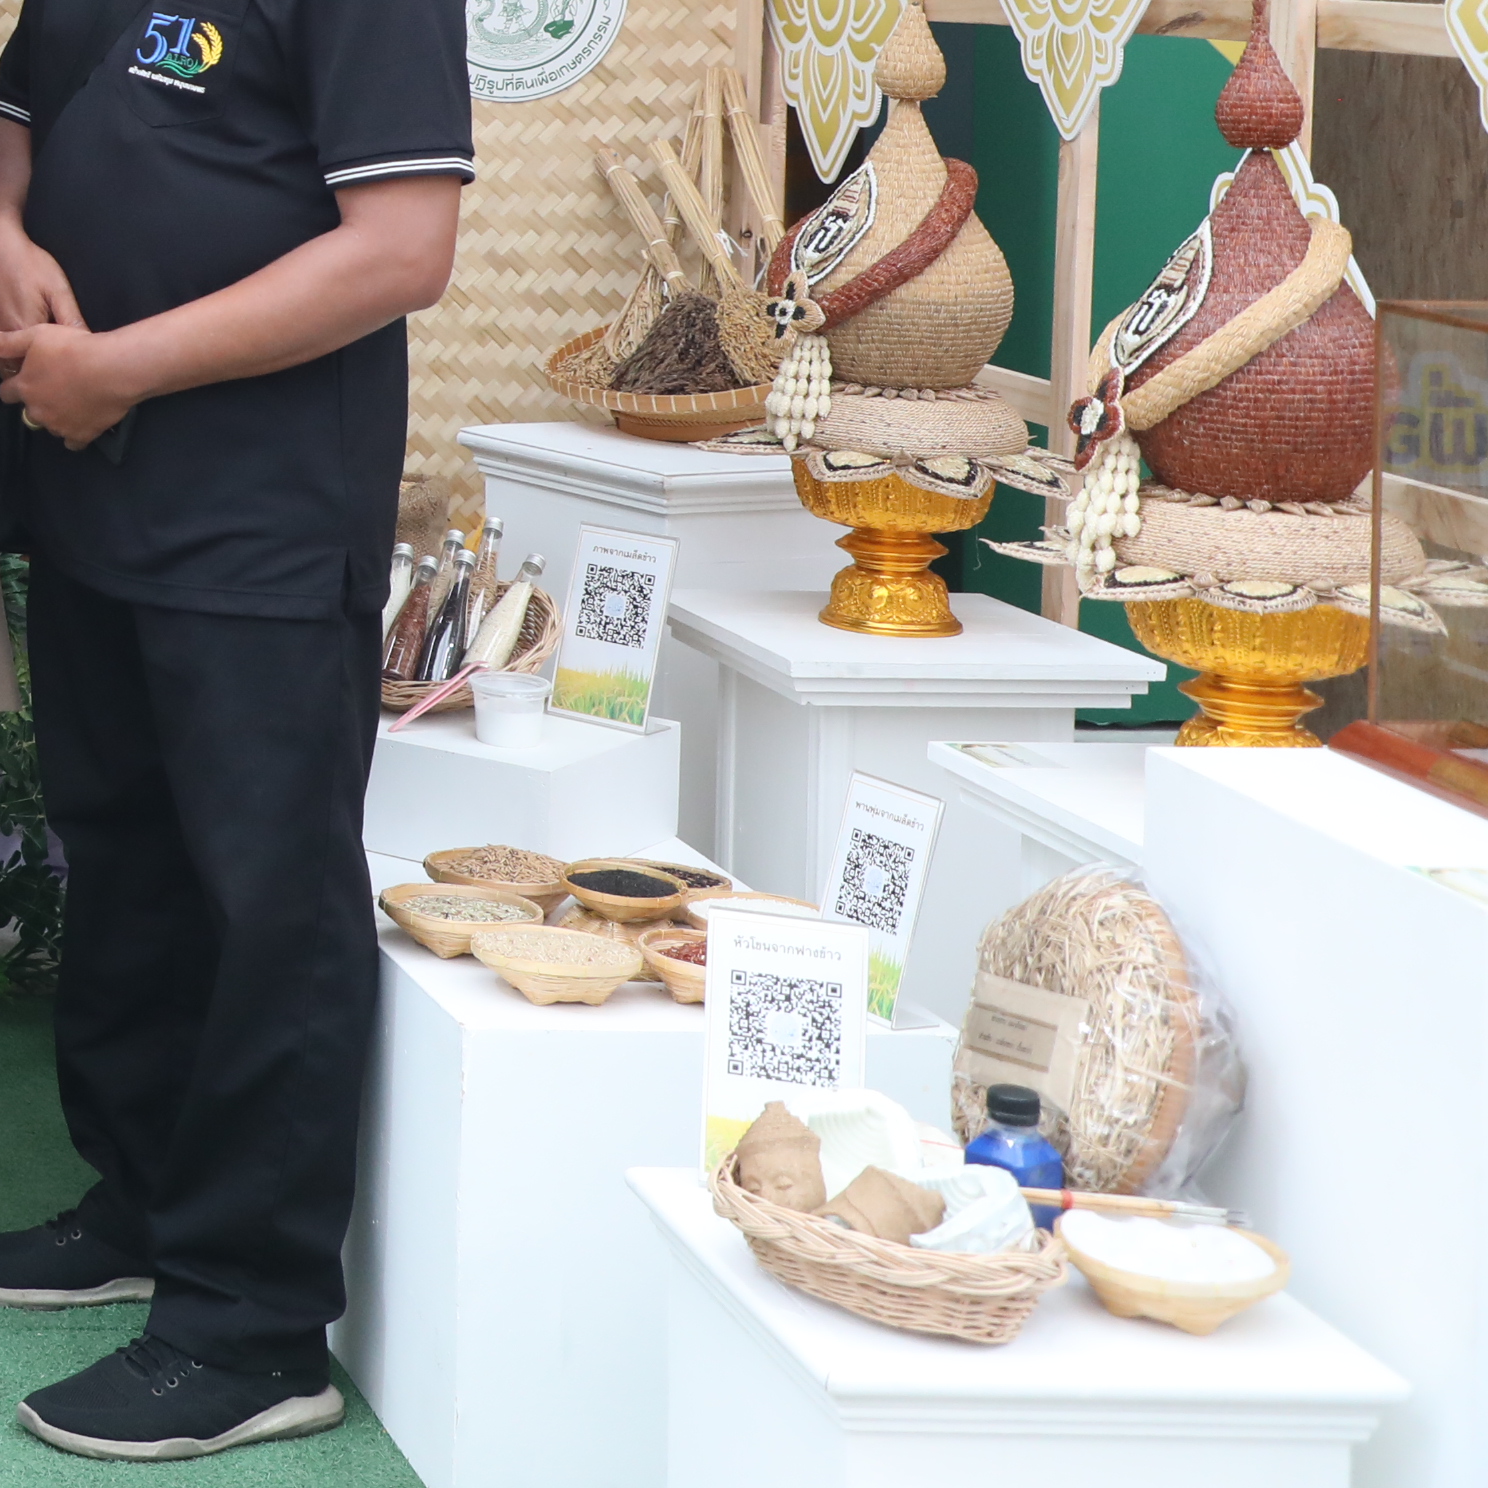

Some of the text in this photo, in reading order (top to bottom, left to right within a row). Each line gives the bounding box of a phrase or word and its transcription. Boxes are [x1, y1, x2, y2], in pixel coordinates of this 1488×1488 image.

[136, 11, 196, 64] 51
[164, 53, 195, 68] ALRO
[592, 545, 657, 564] ภาพจากเมล็ดข้าว
[855, 800, 925, 832] พานพุ่มจากเมล็ดข้าว
[733, 934, 842, 961] หัวโขนจากฟางข้าว
